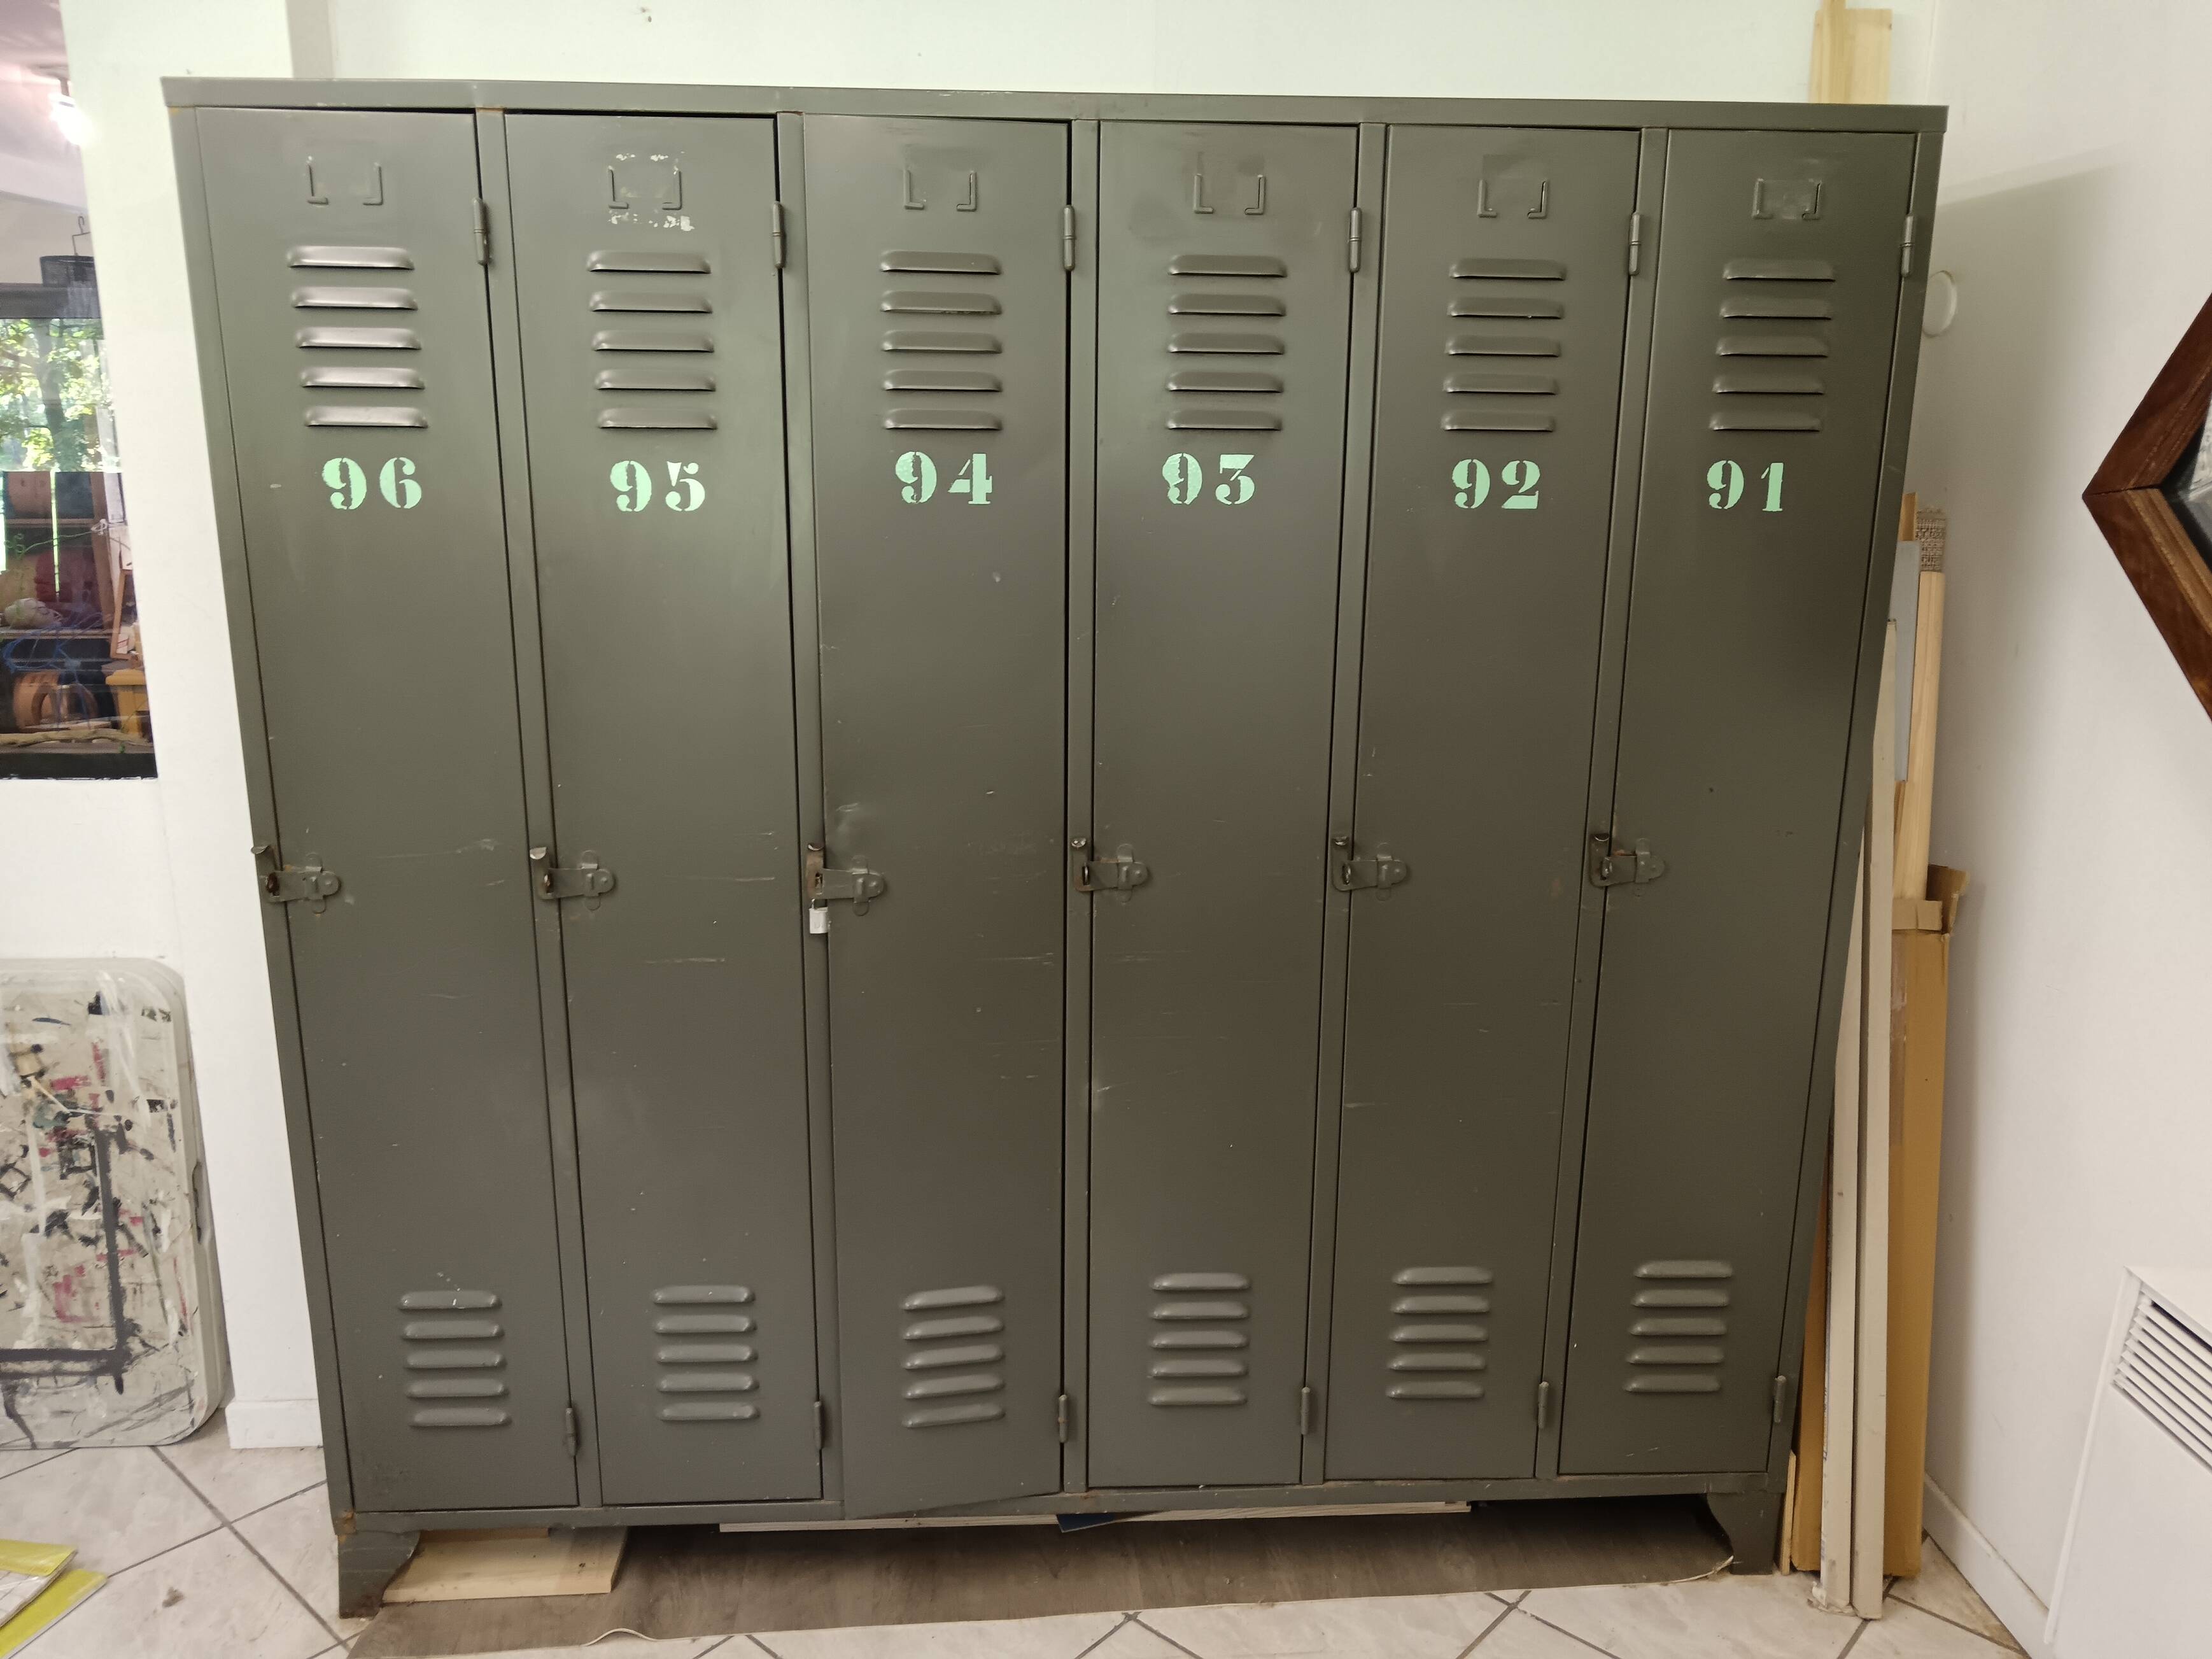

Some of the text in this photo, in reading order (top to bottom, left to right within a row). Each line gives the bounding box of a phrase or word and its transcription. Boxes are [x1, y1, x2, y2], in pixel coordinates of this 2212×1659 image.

[321, 456, 423, 509] 96
[609, 460, 706, 512] 95
[894, 451, 993, 505] 94
[1161, 453, 1255, 505] 93
[1451, 458, 1541, 509] 92
[1707, 460, 1784, 512] 91
